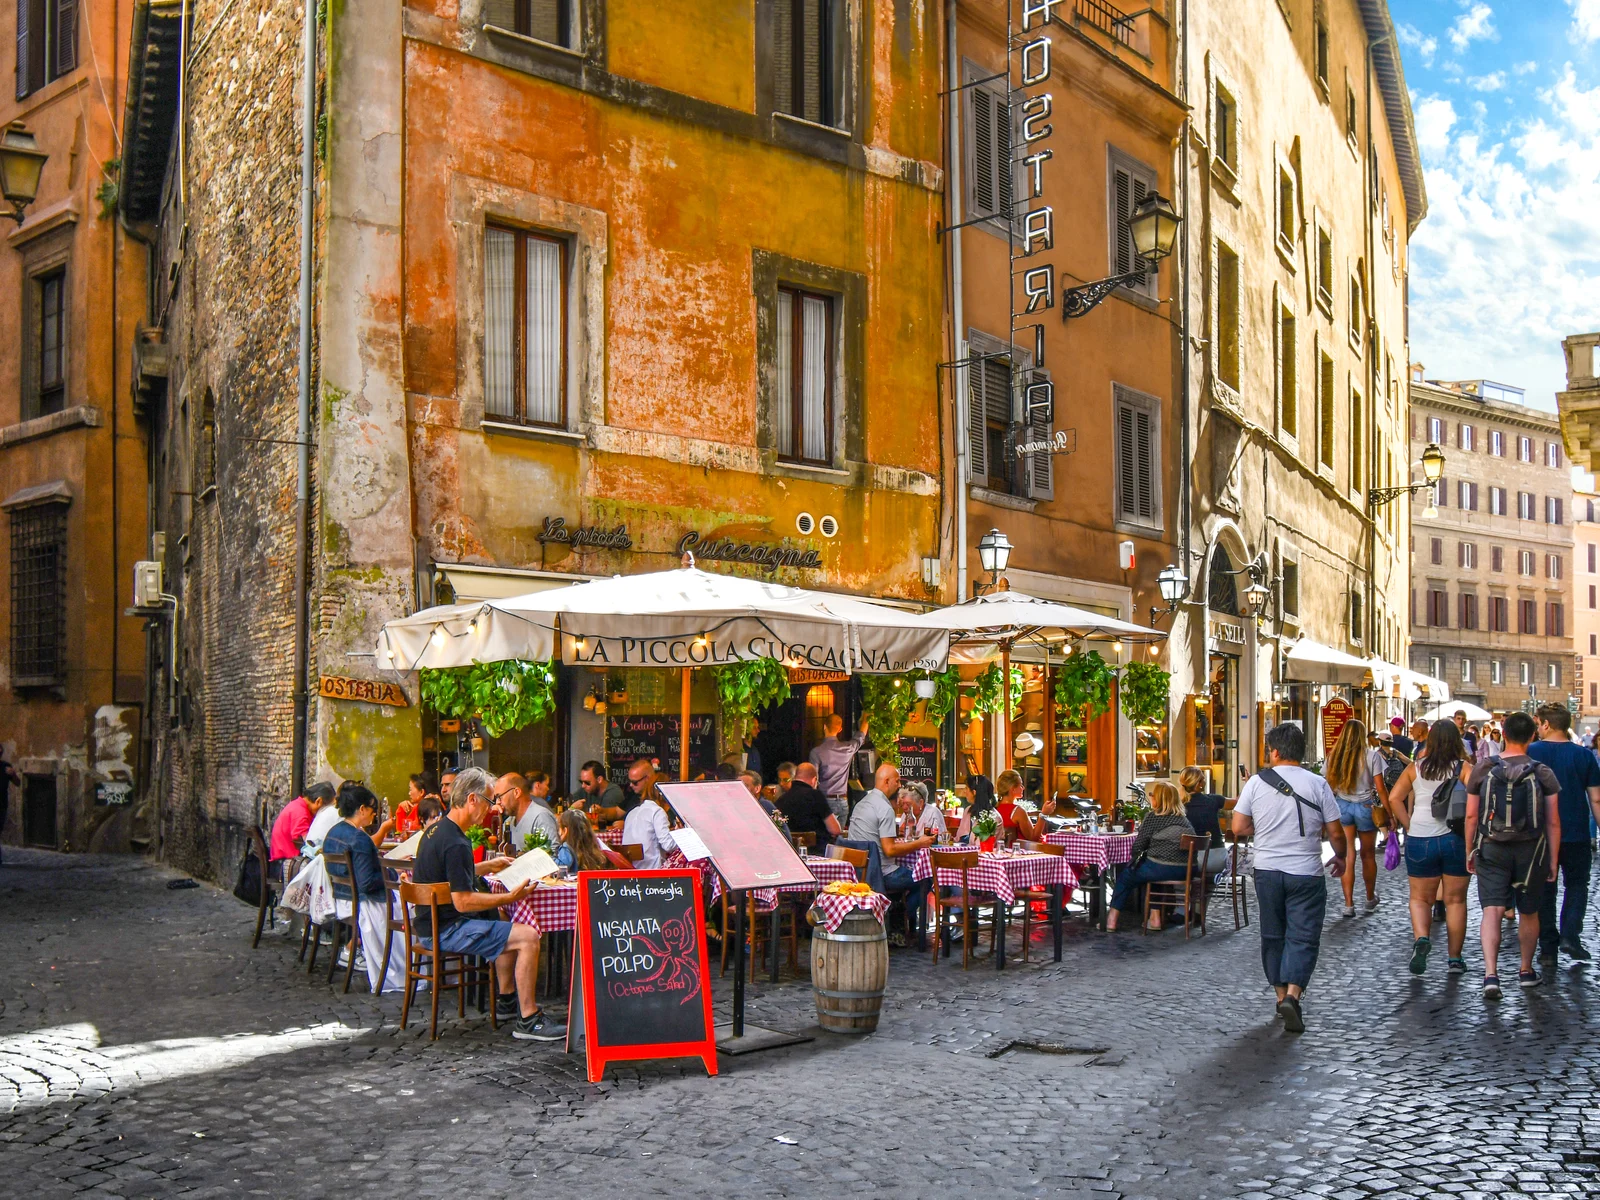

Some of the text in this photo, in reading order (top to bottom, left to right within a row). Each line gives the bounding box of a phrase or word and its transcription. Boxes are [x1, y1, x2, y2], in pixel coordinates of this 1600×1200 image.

[678, 531, 822, 572] Cuccagna
[1225, 623, 1247, 646] SELLA
[620, 636, 740, 664] PICCOLA
[892, 661, 909, 670] DAL
[324, 678, 395, 701] OSTERIA
[920, 767, 933, 777] FETA
[620, 884, 642, 901] chef
[645, 881, 684, 901] consiglia
[597, 918, 661, 939] INSALATA
[616, 937, 633, 953] DI
[601, 954, 654, 977] POLPO
[608, 981, 655, 999] (Octopus
